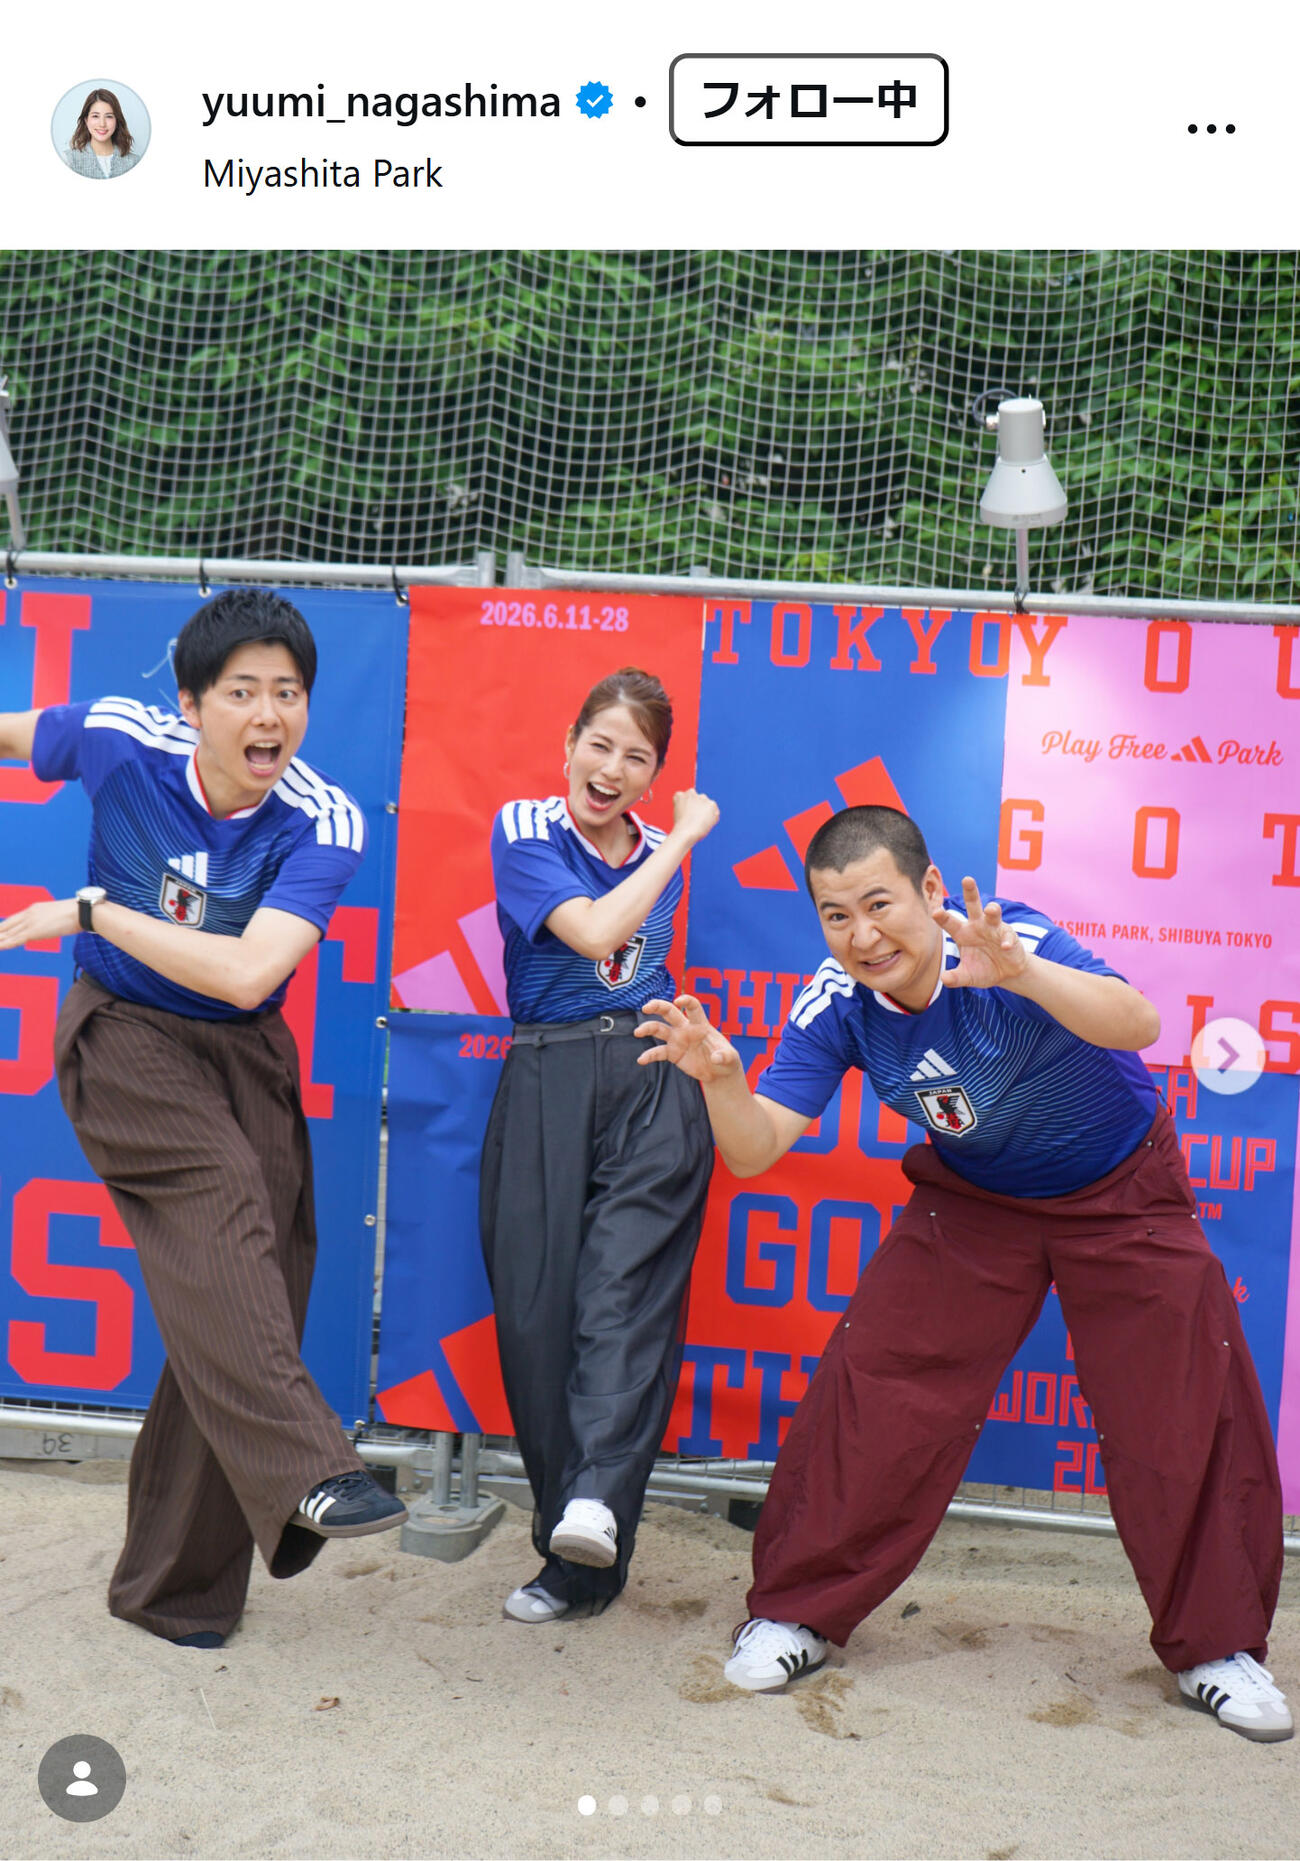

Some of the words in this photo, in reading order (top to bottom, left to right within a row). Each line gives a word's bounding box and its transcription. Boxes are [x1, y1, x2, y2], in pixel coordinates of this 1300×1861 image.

[480, 601, 629, 632] 2026.6.11-28
[705, 600, 1011, 678] TOKYO
[1041, 730, 1103, 763] Play
[1107, 734, 1168, 760] Free
[1217, 740, 1284, 767] Park
[1053, 919, 1106, 938] ASHITA
[1111, 924, 1154, 944] PARK,
[1158, 927, 1222, 945] SHIBUYA
[1226, 932, 1273, 949] TOKYO
[683, 966, 816, 1038] SHI
[1181, 1133, 1276, 1191] CUP
[725, 1191, 906, 1314] GO
[986, 1370, 1095, 1429] WOR
